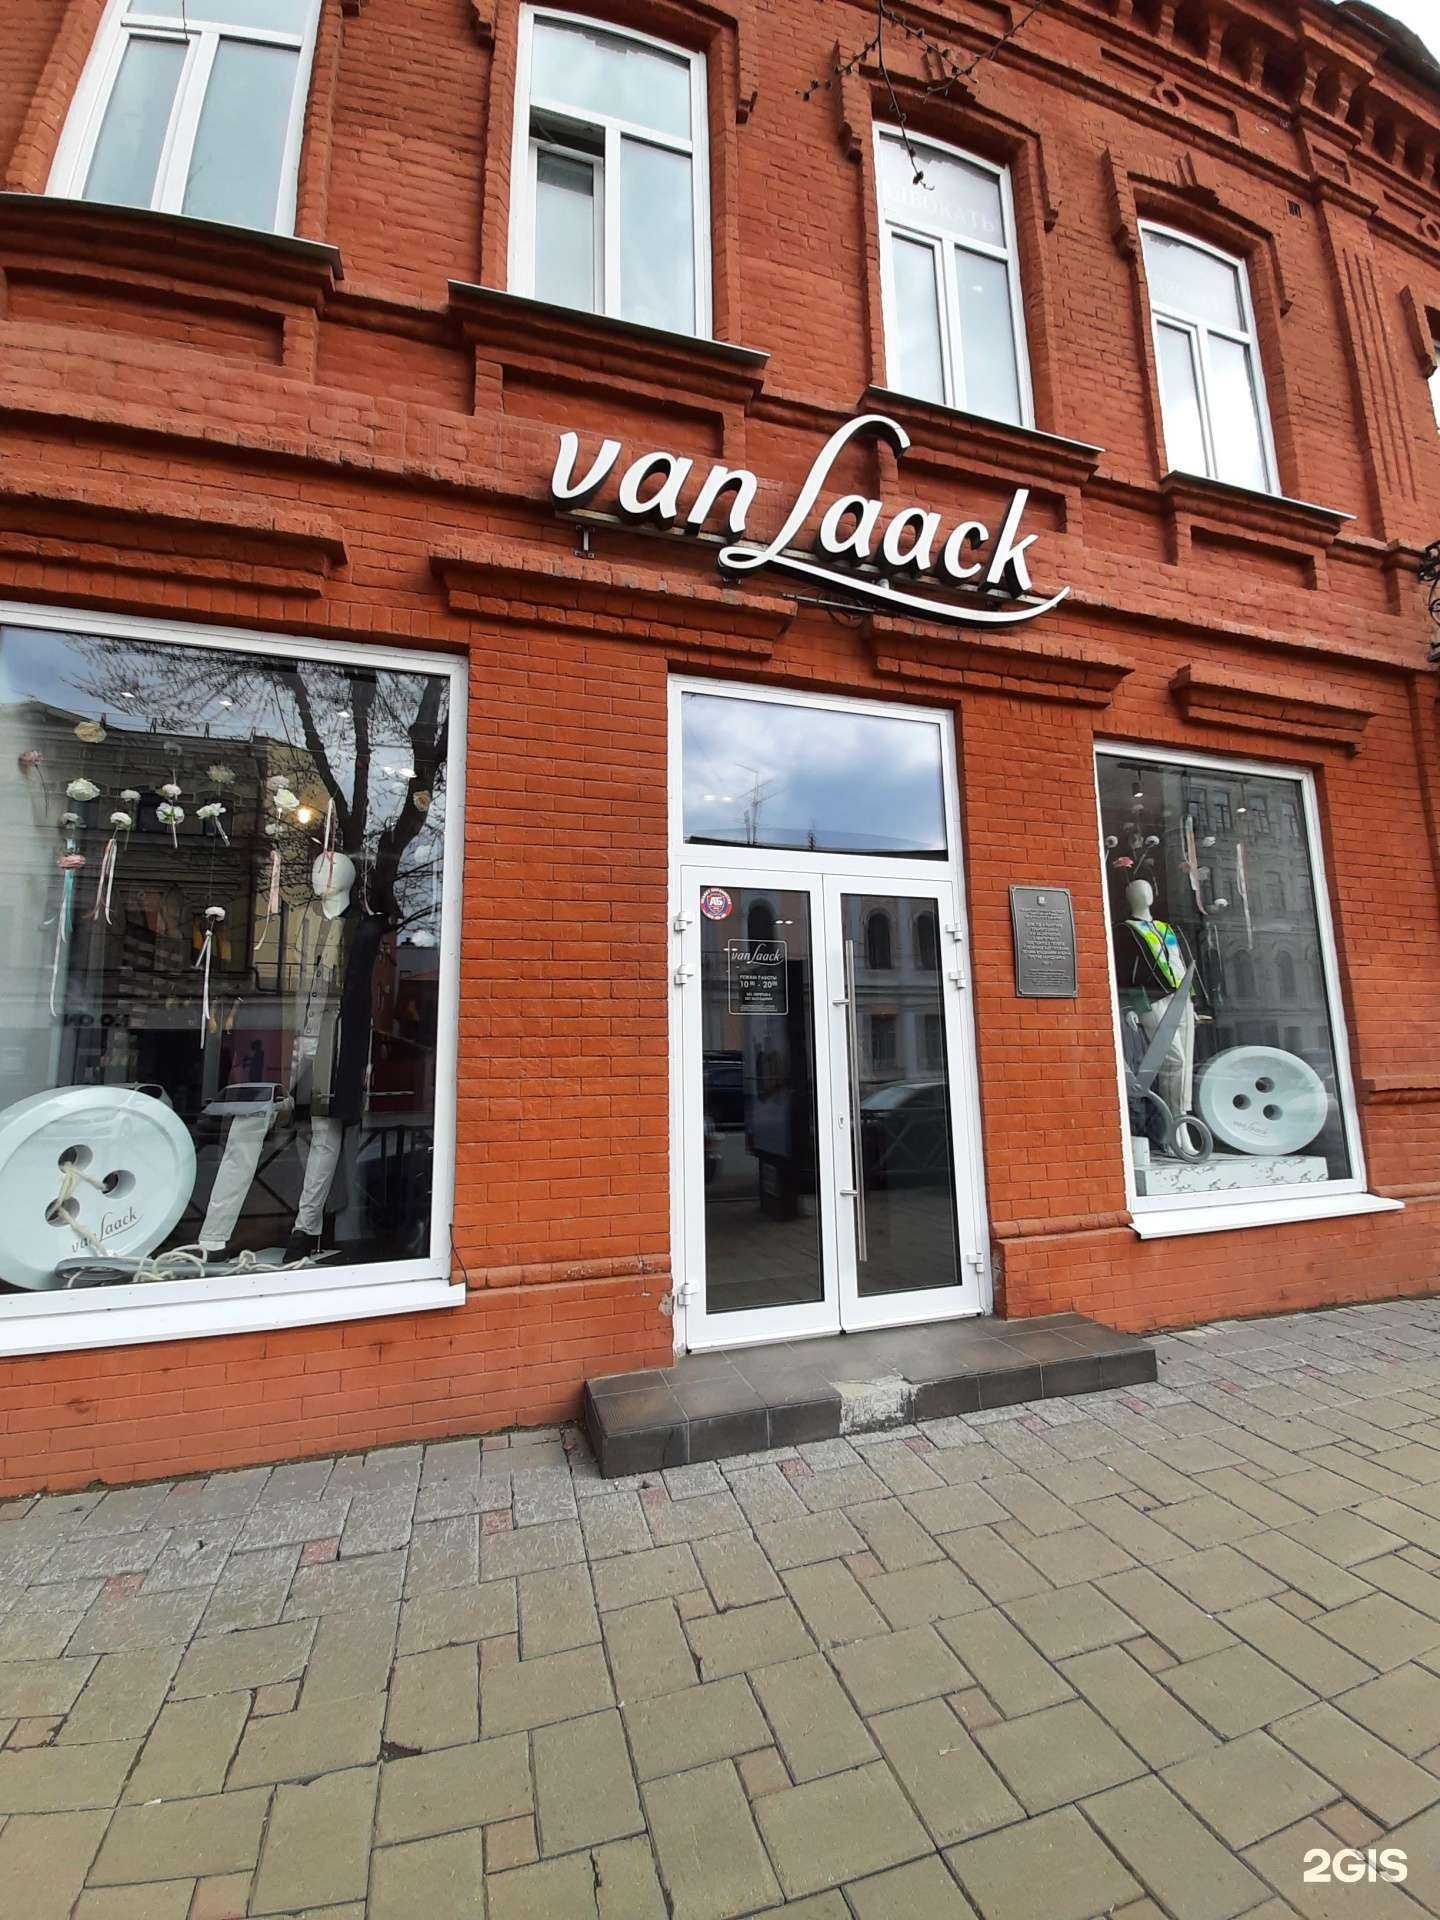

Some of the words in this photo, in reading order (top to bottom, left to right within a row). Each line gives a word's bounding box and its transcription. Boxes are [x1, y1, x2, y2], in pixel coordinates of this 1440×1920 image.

[551, 431, 758, 536] van
[718, 414, 1071, 624] Laack
[731, 951, 750, 960] van
[746, 943, 784, 966] Laack
[99, 1206, 144, 1242] Laack
